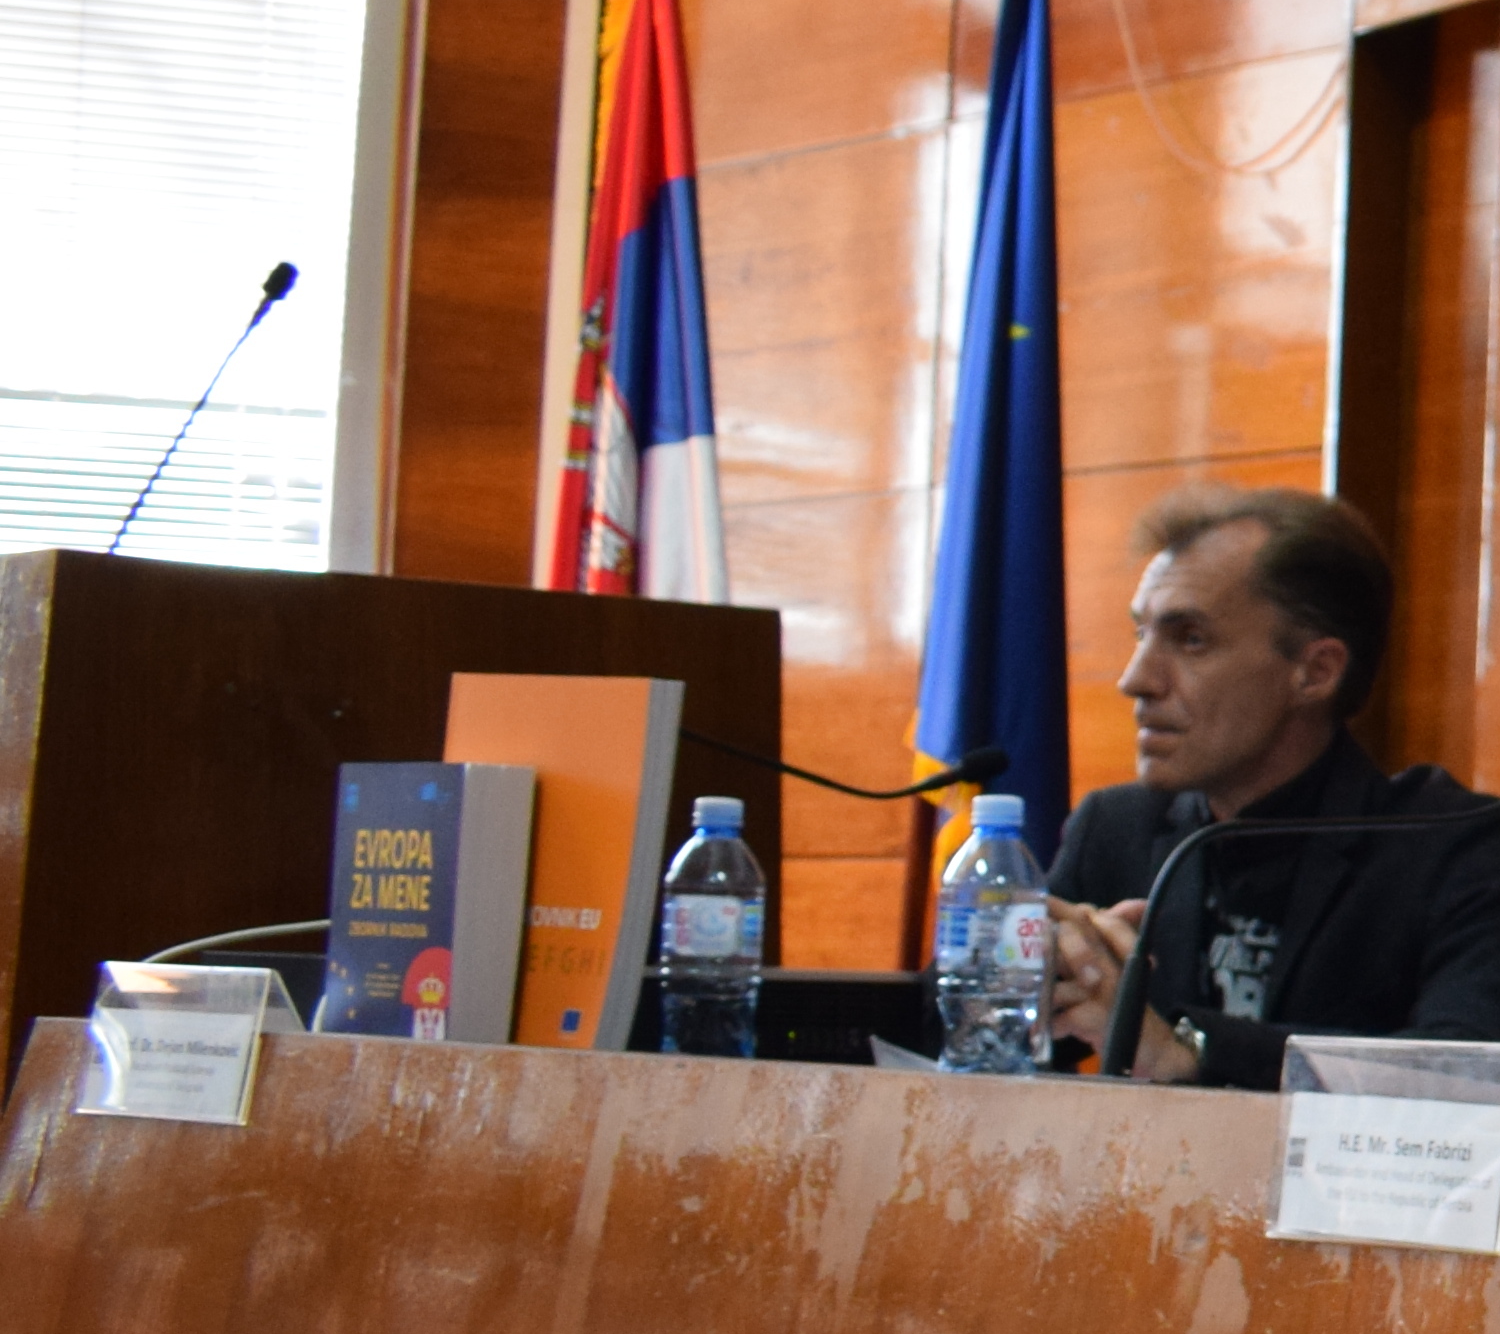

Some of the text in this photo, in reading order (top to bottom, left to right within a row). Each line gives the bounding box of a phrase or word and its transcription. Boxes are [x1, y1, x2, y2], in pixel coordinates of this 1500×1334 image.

[354, 830, 433, 869] EVROPA
[350, 875, 431, 911] ZA MENE
[1338, 1134, 1473, 1162] H.E. Mr. Sem Fabrizi
